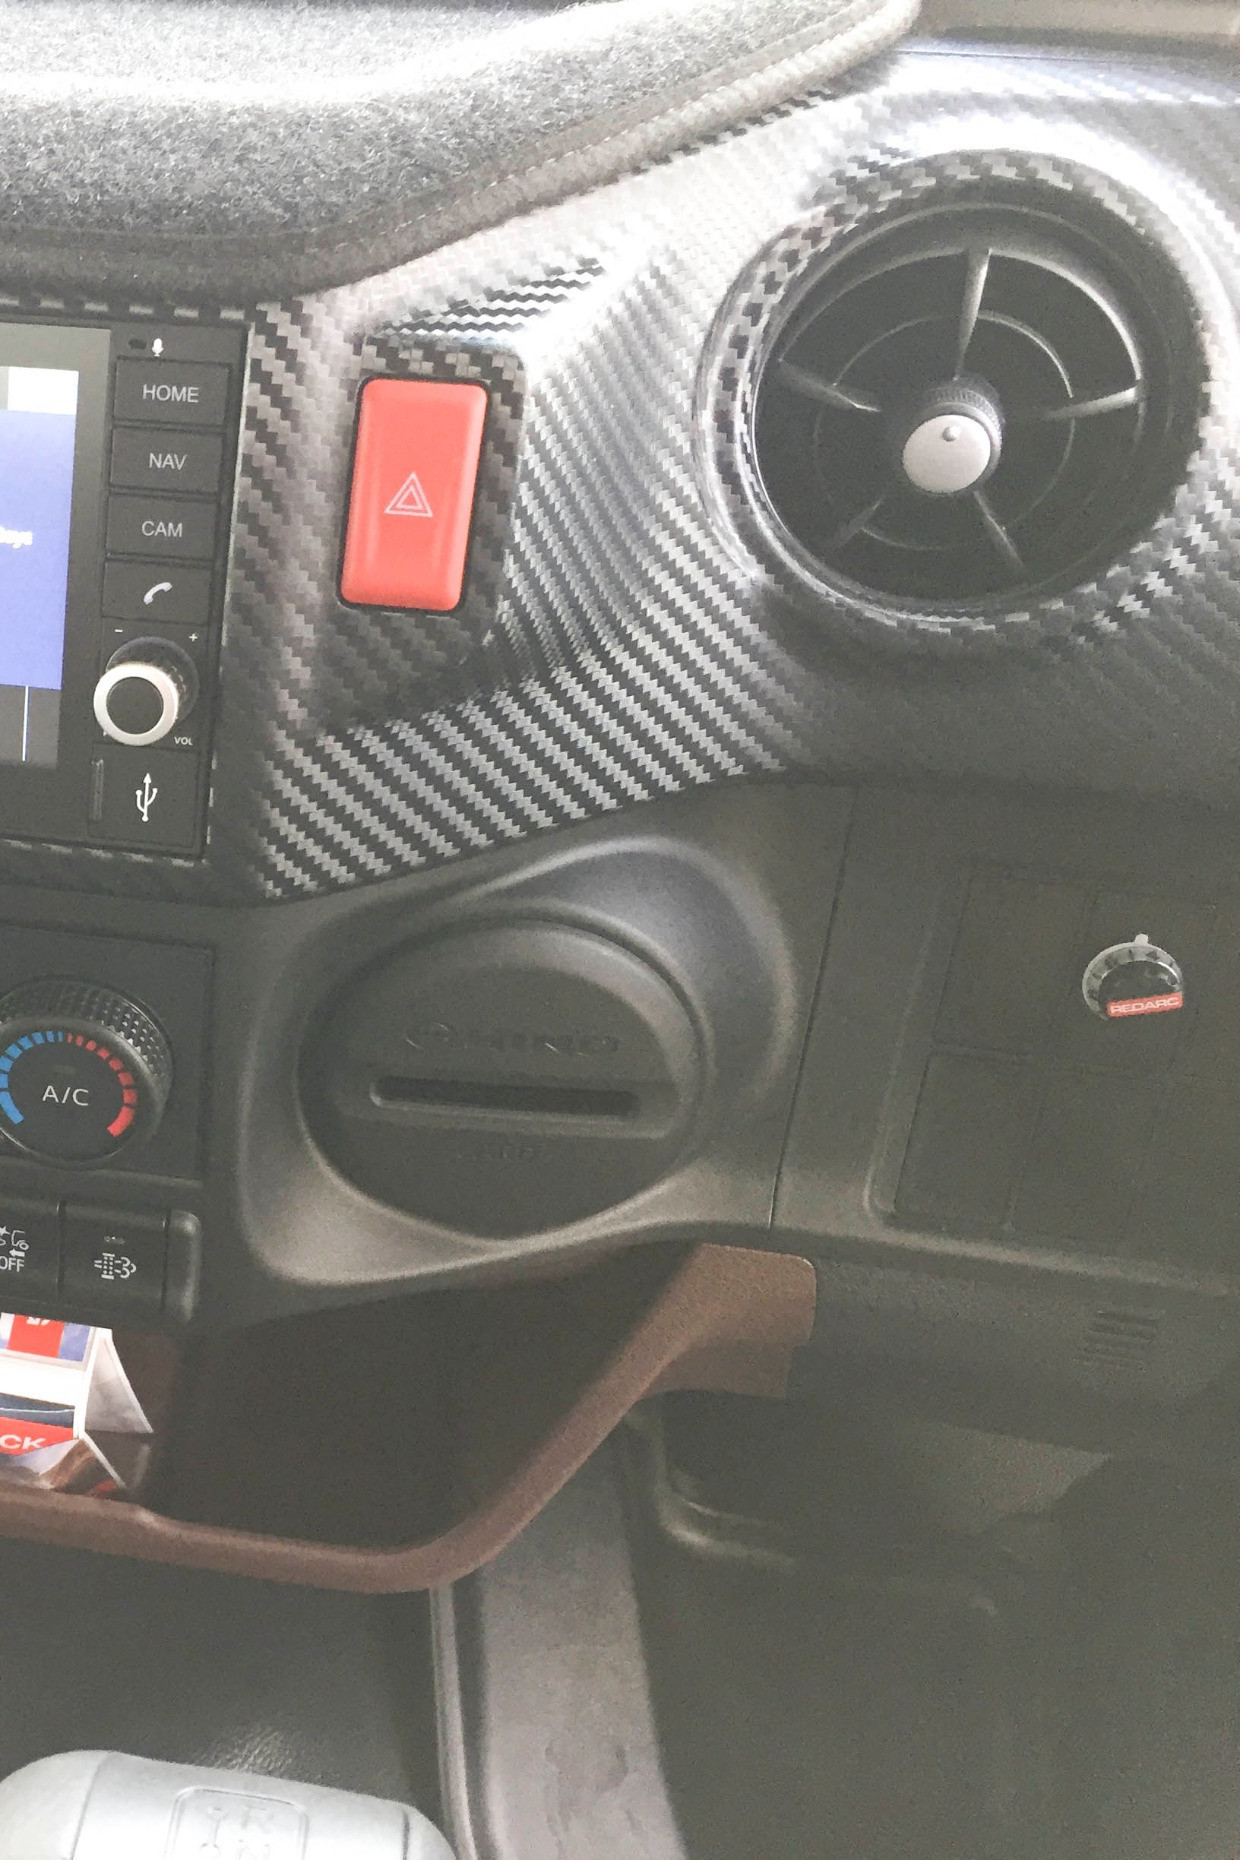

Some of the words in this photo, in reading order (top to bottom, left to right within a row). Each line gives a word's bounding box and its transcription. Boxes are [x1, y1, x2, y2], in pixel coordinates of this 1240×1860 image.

[142, 384, 200, 403] HOME
[148, 452, 188, 471] NAV
[141, 520, 183, 538] CAM
[173, 735, 194, 747] VOL
[1110, 997, 1179, 1014] REDARC
[42, 1084, 90, 1107] A/C
